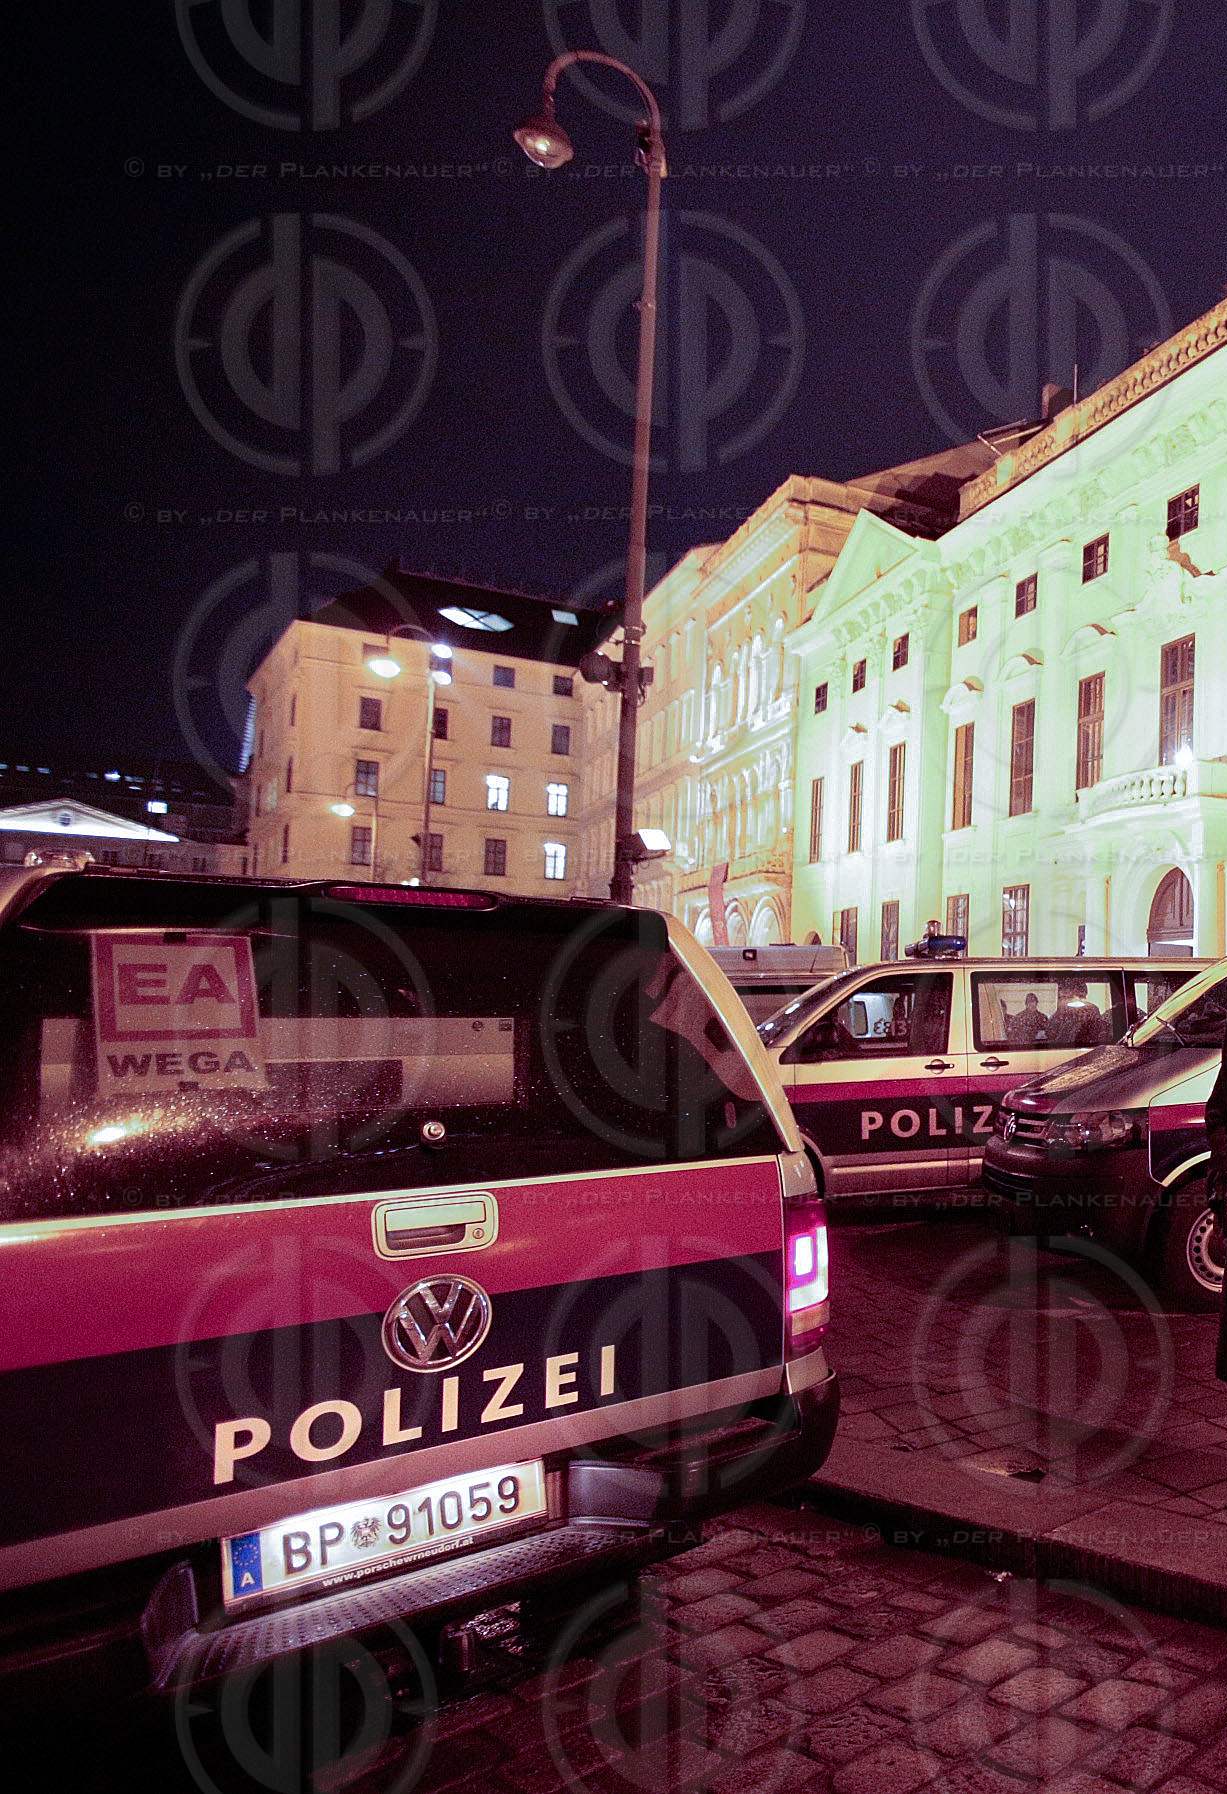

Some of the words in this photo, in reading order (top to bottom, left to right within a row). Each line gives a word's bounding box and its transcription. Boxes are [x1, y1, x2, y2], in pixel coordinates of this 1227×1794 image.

[117, 964, 237, 1005] EA
[107, 1051, 254, 1077] WEGA
[861, 1105, 993, 1140] POLIZ
[214, 1344, 615, 1485] POLIZEI
[282, 1521, 344, 1575] BP
[387, 1475, 519, 1545] 91059
[240, 1572, 255, 1587] A
[322, 1536, 474, 1587] www.porschewrneudorf.at
